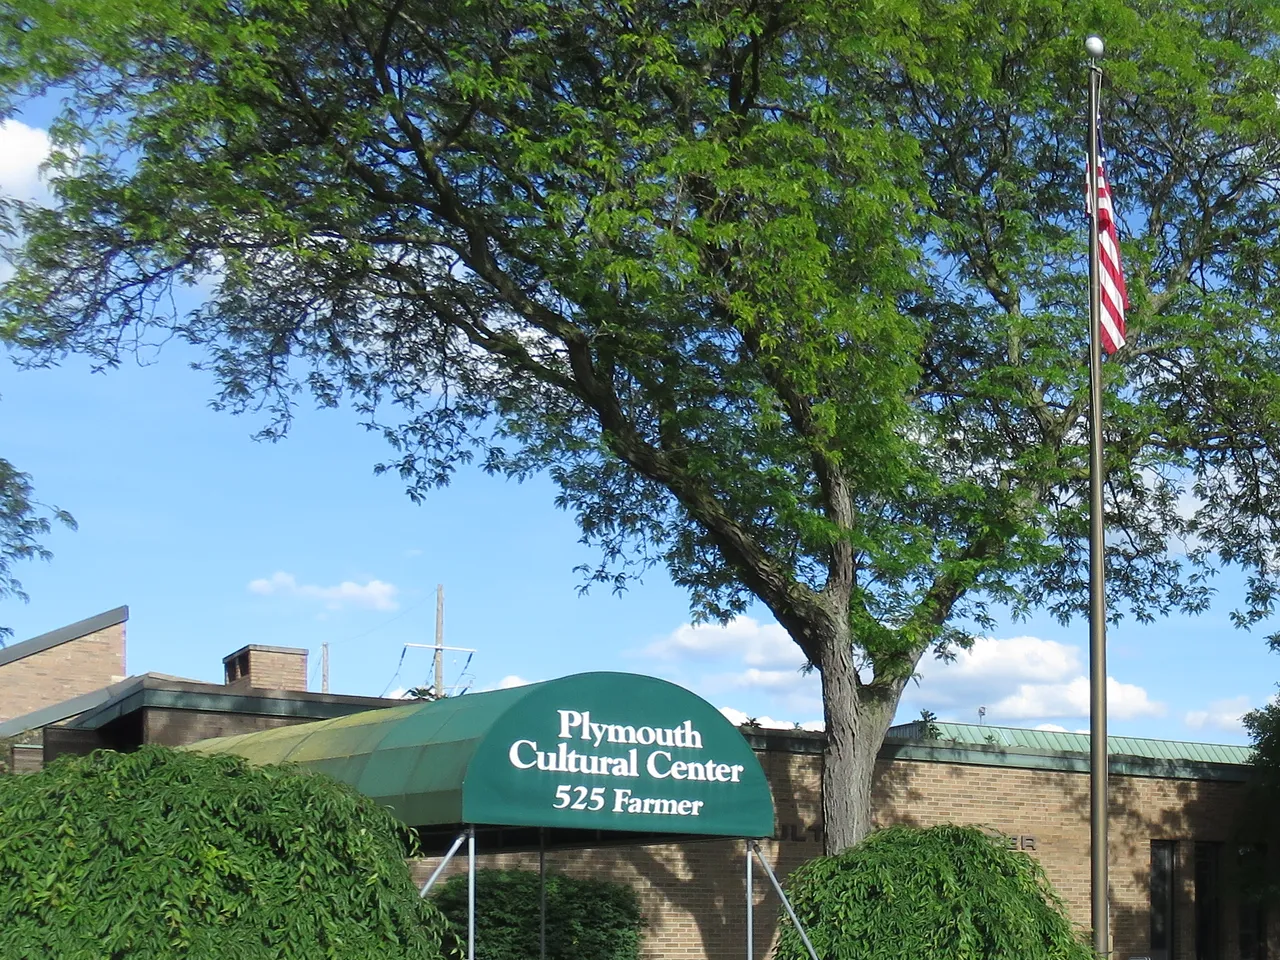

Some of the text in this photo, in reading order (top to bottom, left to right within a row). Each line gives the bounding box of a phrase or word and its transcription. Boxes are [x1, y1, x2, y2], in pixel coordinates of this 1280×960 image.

[557, 709, 703, 748] Plymouth
[509, 739, 744, 782] Cultural Center
[553, 784, 704, 816] 525 Farmer
